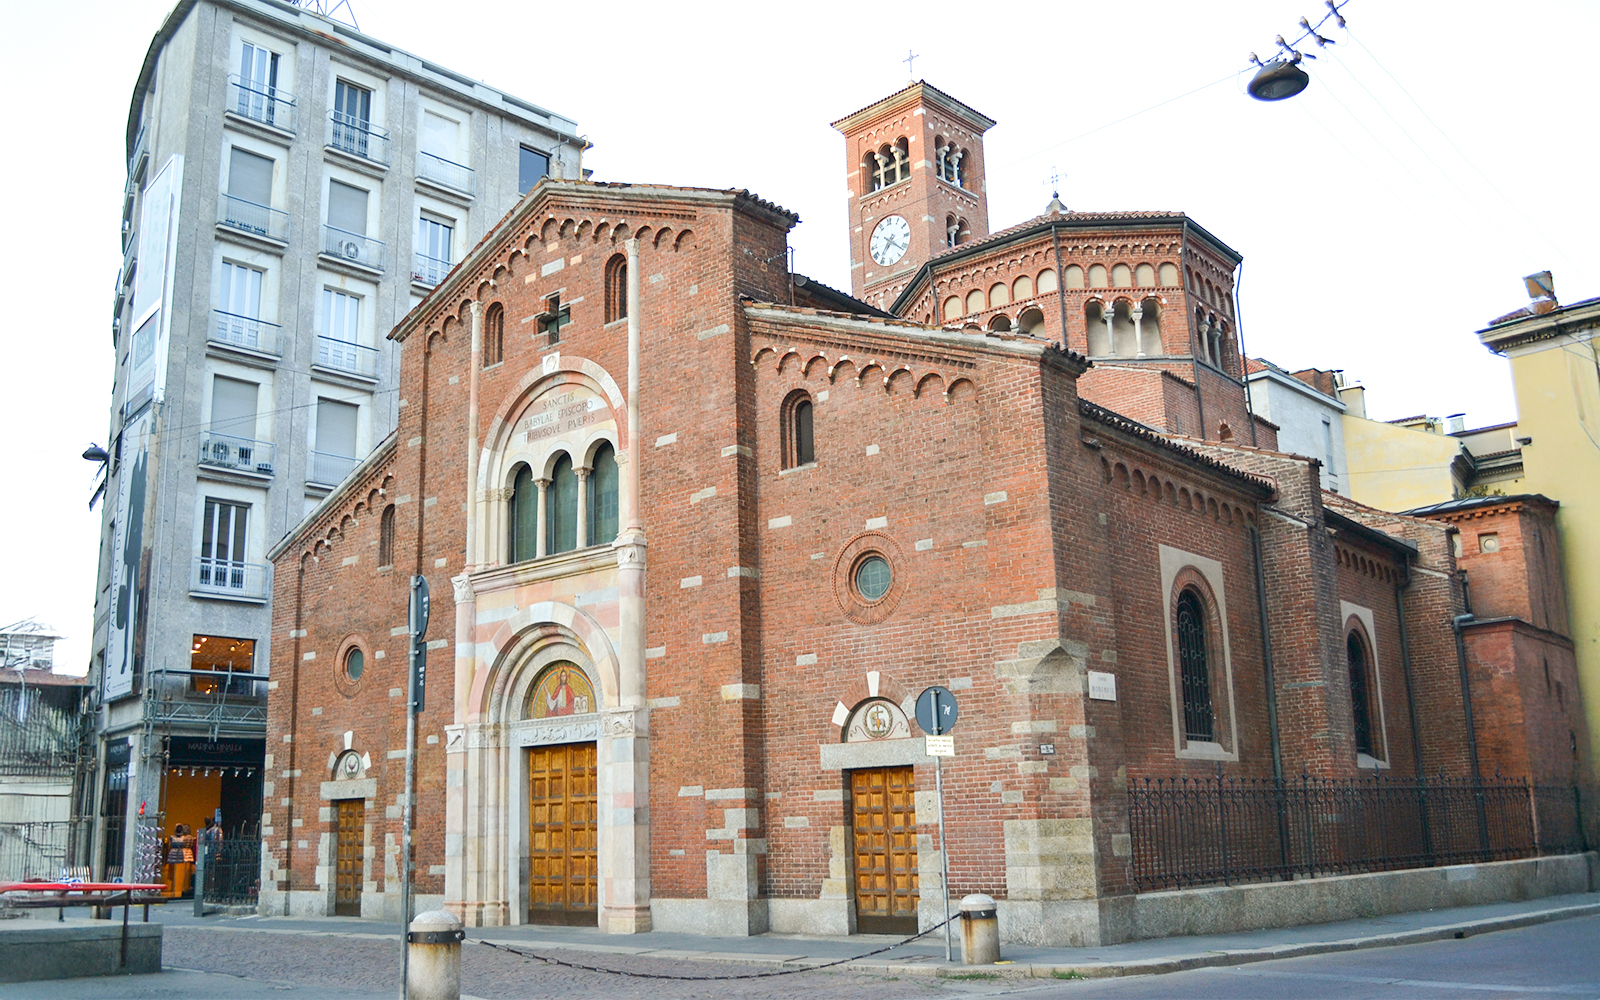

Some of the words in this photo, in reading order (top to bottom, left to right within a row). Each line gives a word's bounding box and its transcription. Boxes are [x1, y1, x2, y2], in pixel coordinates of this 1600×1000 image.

[542, 392, 575, 410] SANCTIS
[524, 412, 553, 430] BABYLAE
[557, 400, 593, 419] EPISCOPO
[567, 413, 595, 429] PVERIS
[105, 559, 119, 694] ALESSANDRO
